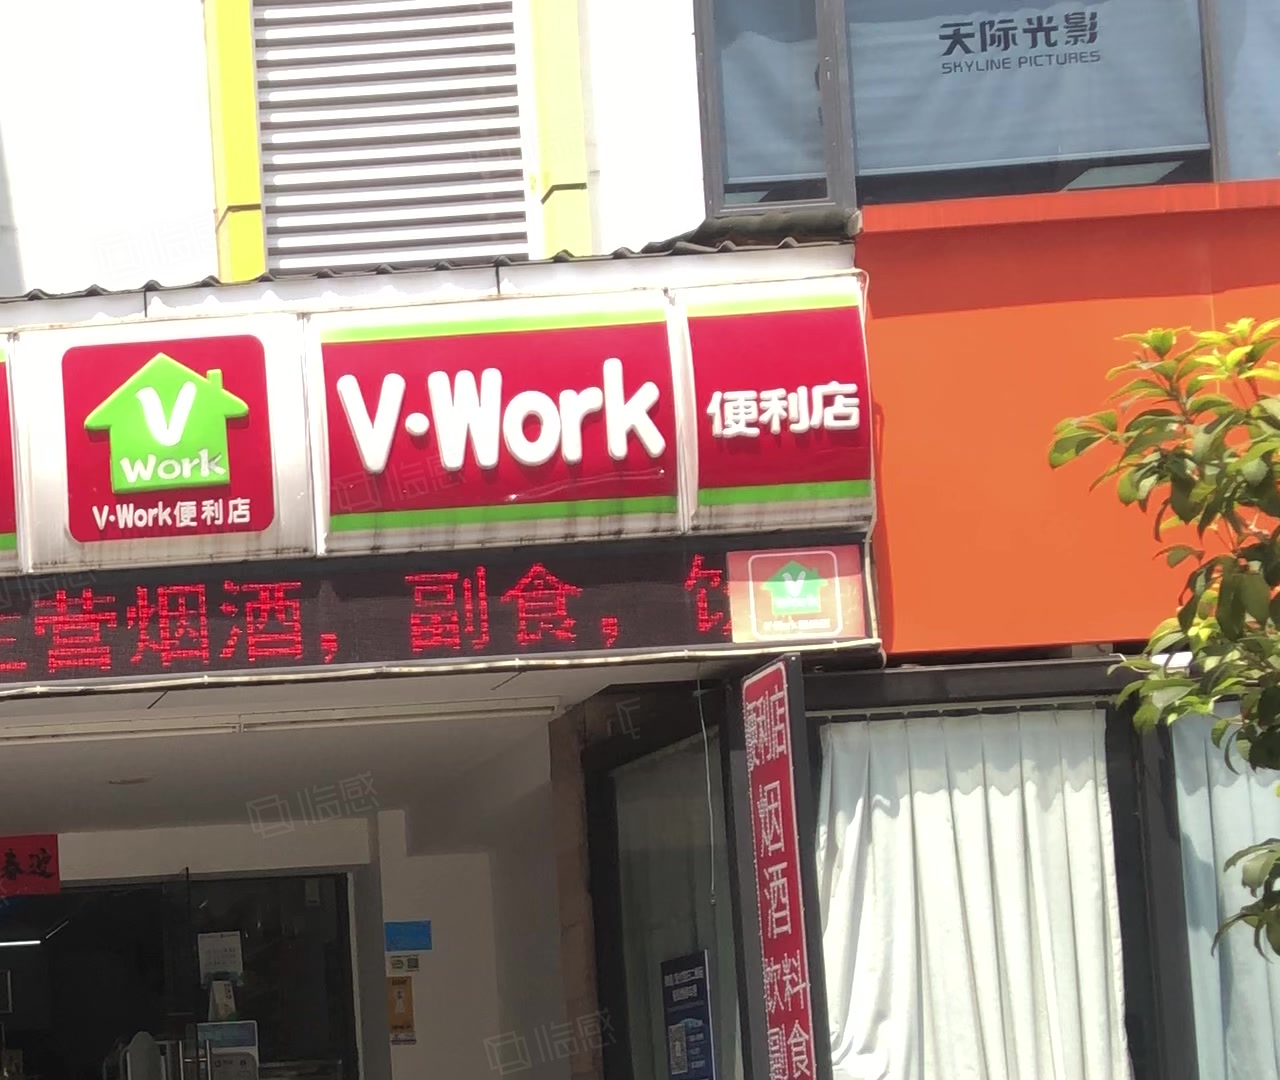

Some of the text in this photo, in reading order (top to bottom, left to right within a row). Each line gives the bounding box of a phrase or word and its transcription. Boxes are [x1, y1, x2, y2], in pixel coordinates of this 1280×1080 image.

[939, 11, 1098, 56] 天际光影
[941, 50, 1101, 74] SKYLINE PICTURES
[707, 381, 860, 438] 便利店
[120, 449, 227, 482] Work
